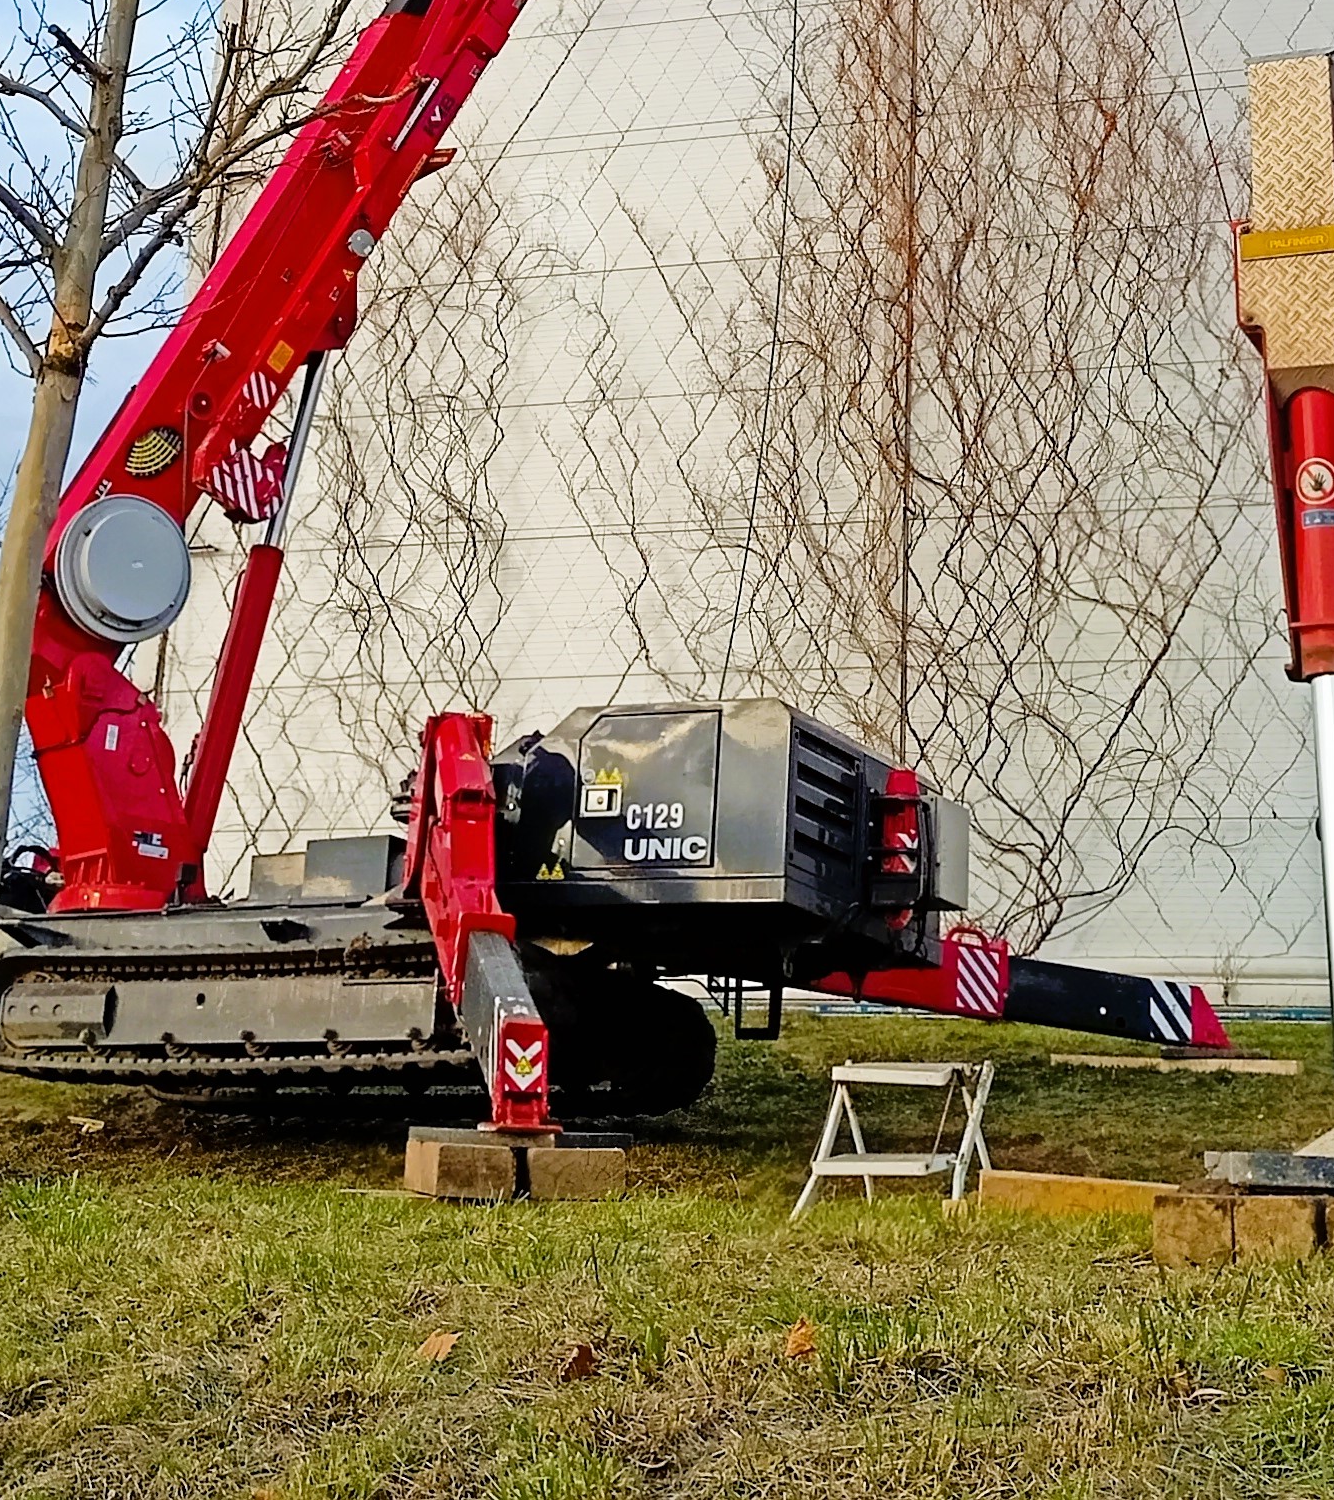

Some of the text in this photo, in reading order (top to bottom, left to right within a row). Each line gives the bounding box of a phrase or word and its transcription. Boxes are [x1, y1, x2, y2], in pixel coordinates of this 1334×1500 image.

[1270, 234, 1325, 248] PALFINGER
[626, 802, 684, 830] C129
[623, 835, 708, 861] UNIC
